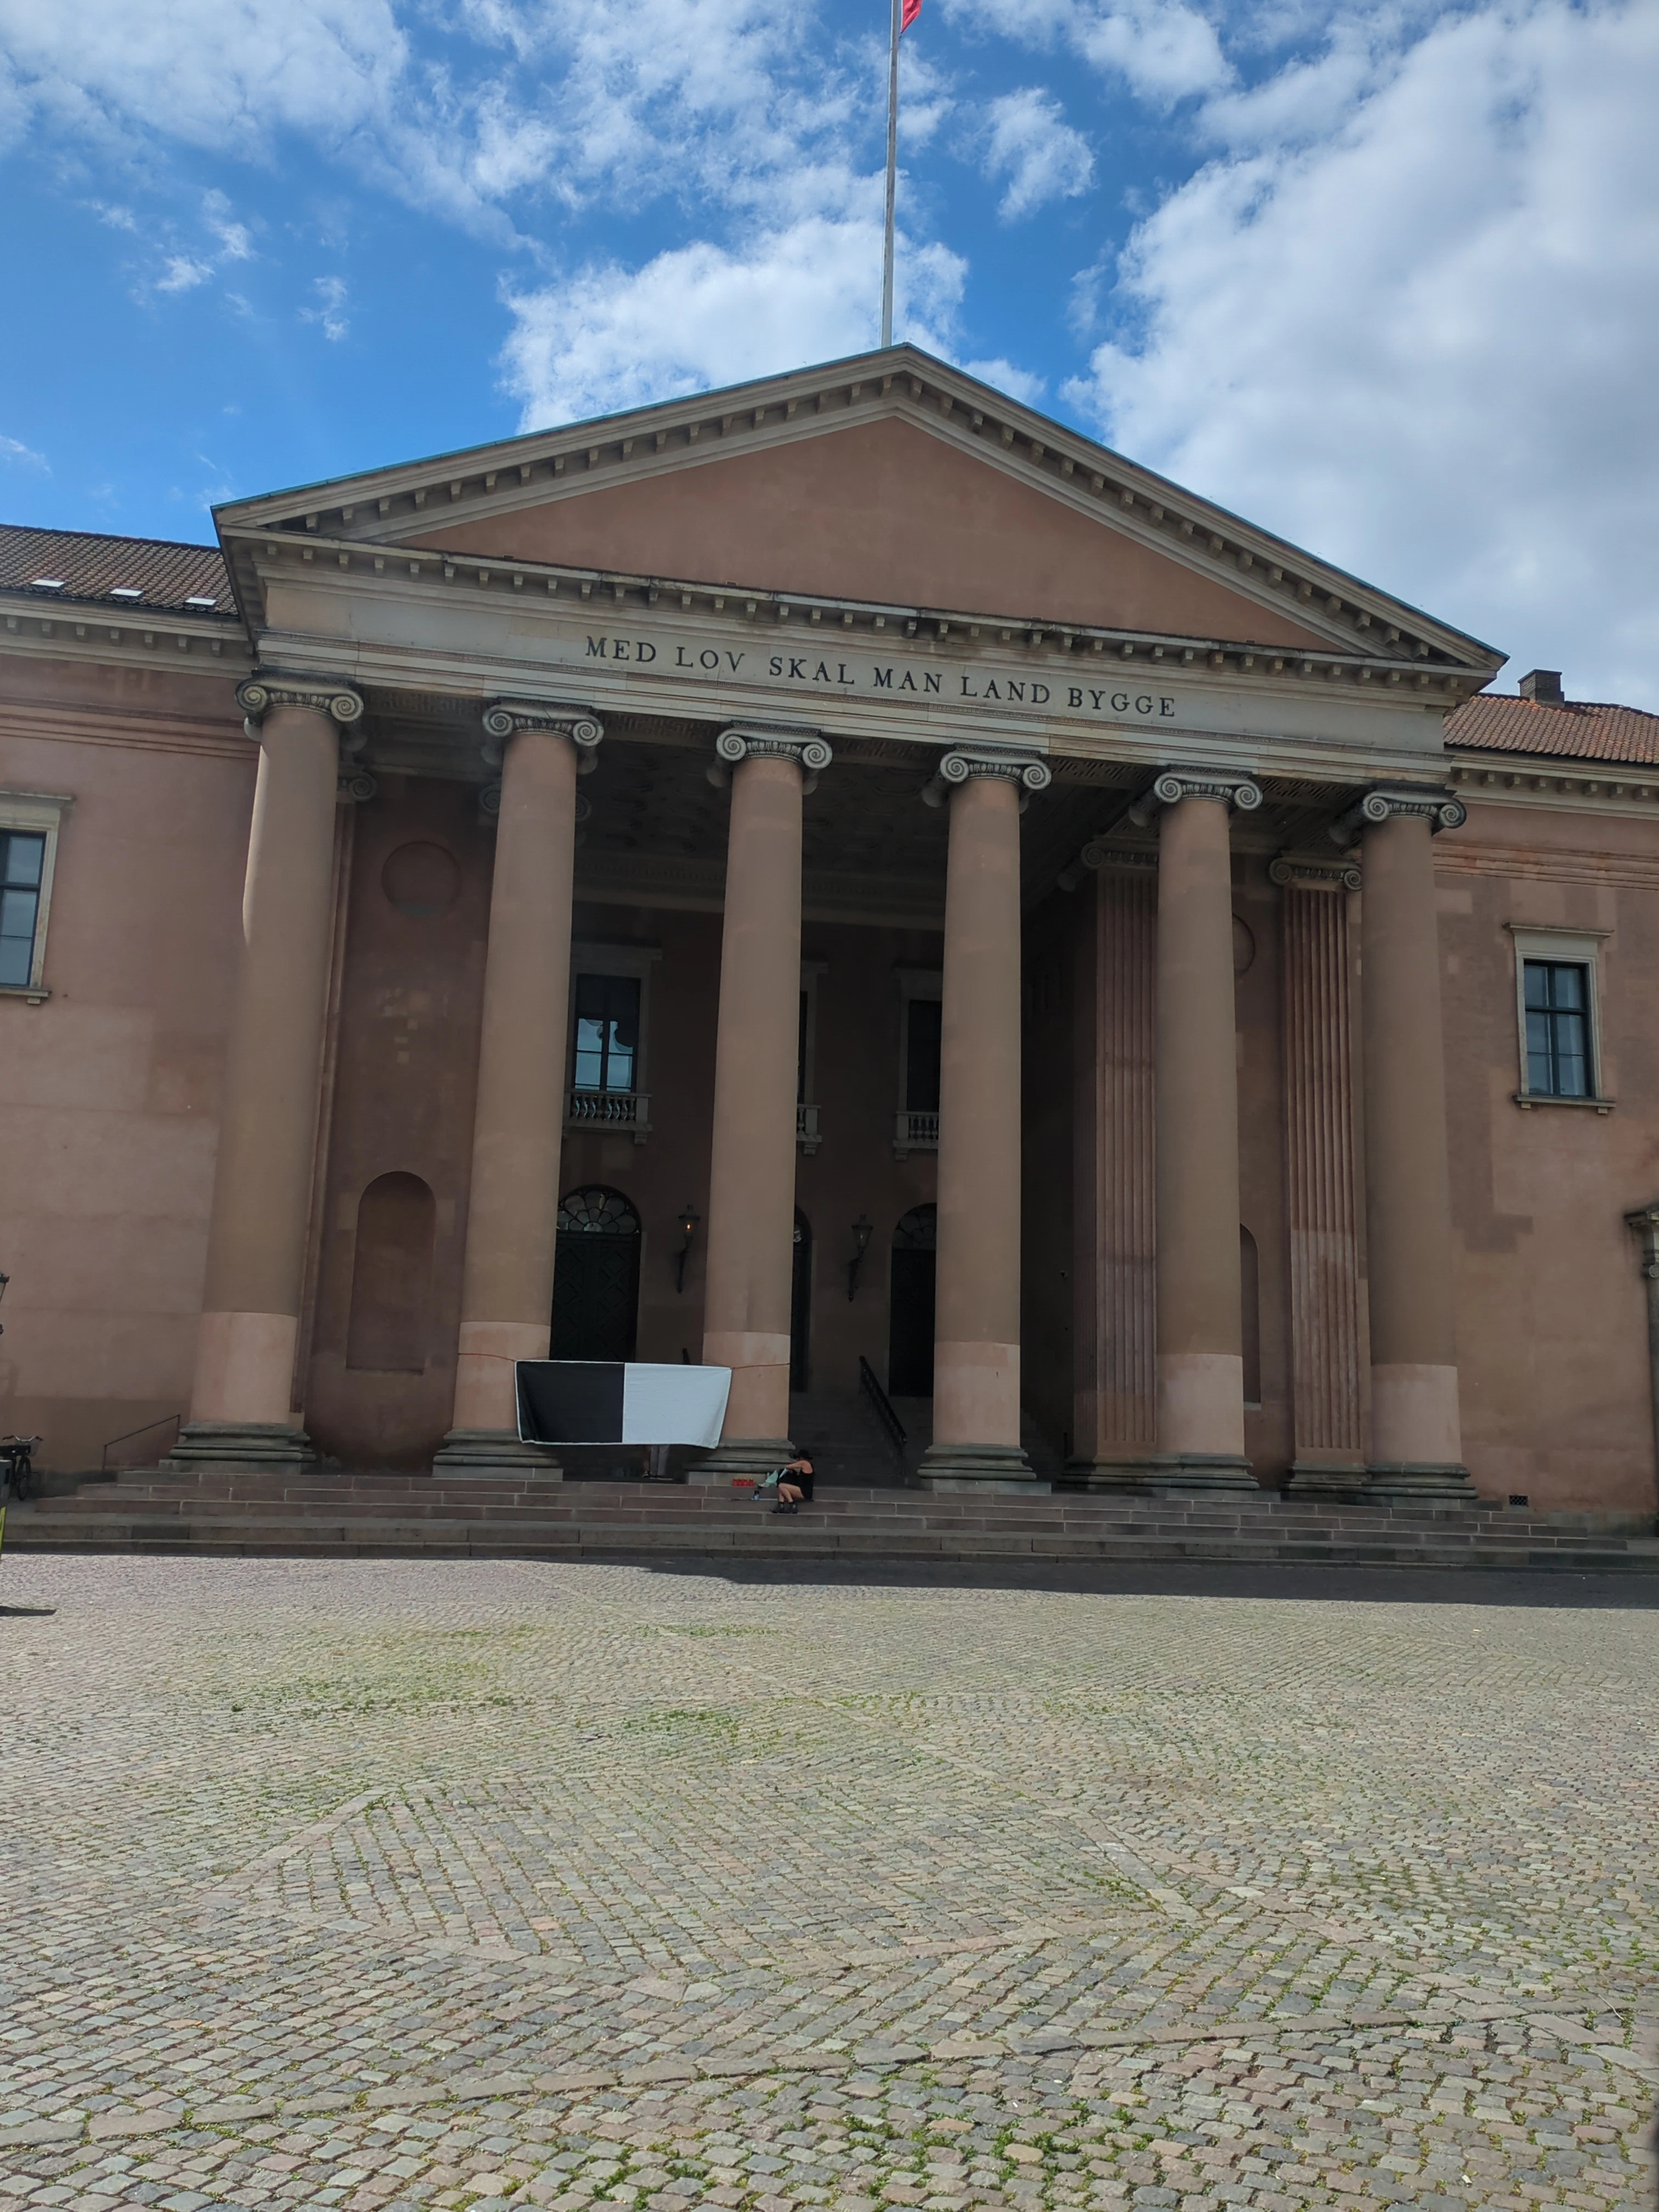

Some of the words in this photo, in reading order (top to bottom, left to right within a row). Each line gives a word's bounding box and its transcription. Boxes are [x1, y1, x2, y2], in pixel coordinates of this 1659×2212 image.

[585, 636, 657, 663] MED
[675, 647, 745, 672] LOV
[769, 657, 855, 685] SKAL
[873, 667, 943, 693] MAN
[960, 676, 1051, 704] LAND
[1068, 687, 1176, 717] BYGGE
